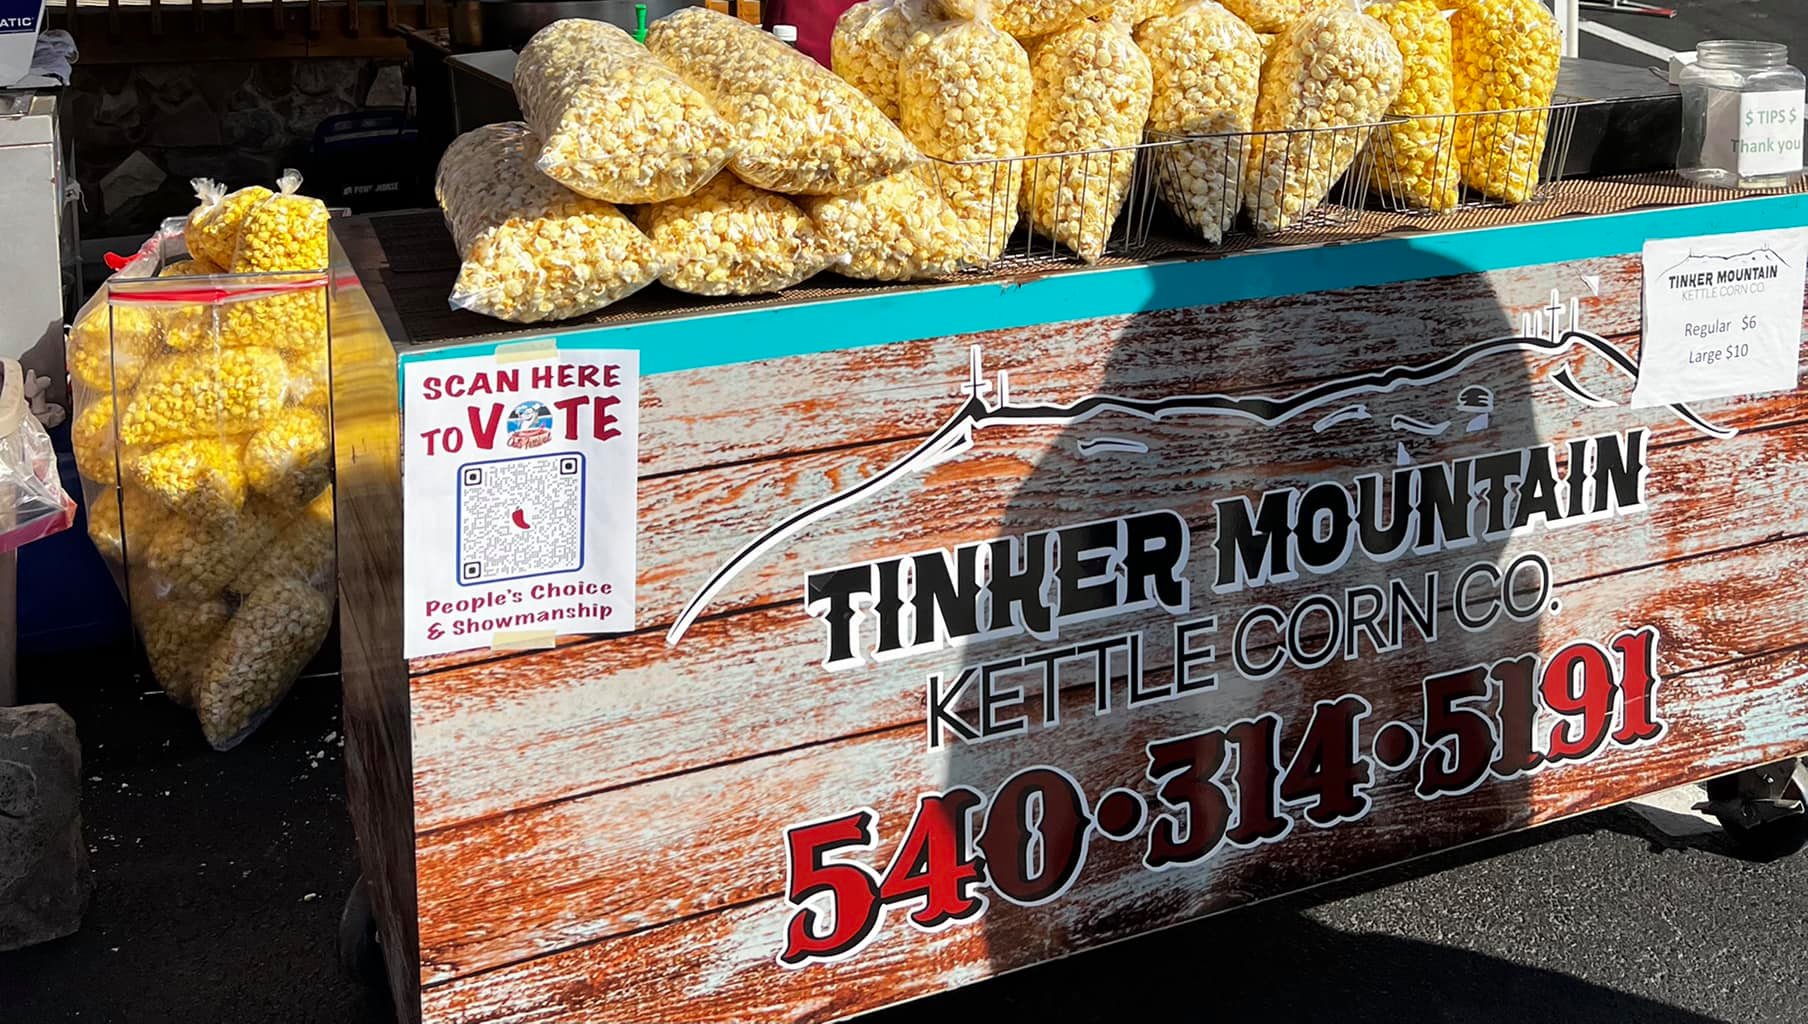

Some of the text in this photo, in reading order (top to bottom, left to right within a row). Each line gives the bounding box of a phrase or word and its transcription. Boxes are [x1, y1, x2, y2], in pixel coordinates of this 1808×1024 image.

[1745, 107, 1797, 127] $ TIPS $
[1730, 138, 1801, 154] Thank you
[1669, 265, 1778, 289] TINKER MOUNTAIN
[1682, 287, 1718, 302] KETTLE
[1719, 283, 1748, 297] CORN
[1684, 315, 1757, 338] Regular $6
[1688, 343, 1749, 364] Large $10
[422, 364, 621, 400] SCAN HERE
[420, 426, 463, 456] TO
[804, 428, 1649, 672] TINKER MOUNTAIN
[425, 581, 612, 617] People's Choice
[427, 603, 613, 640] & Showmanship
[927, 551, 1561, 752] KETTLE CORN CO.
